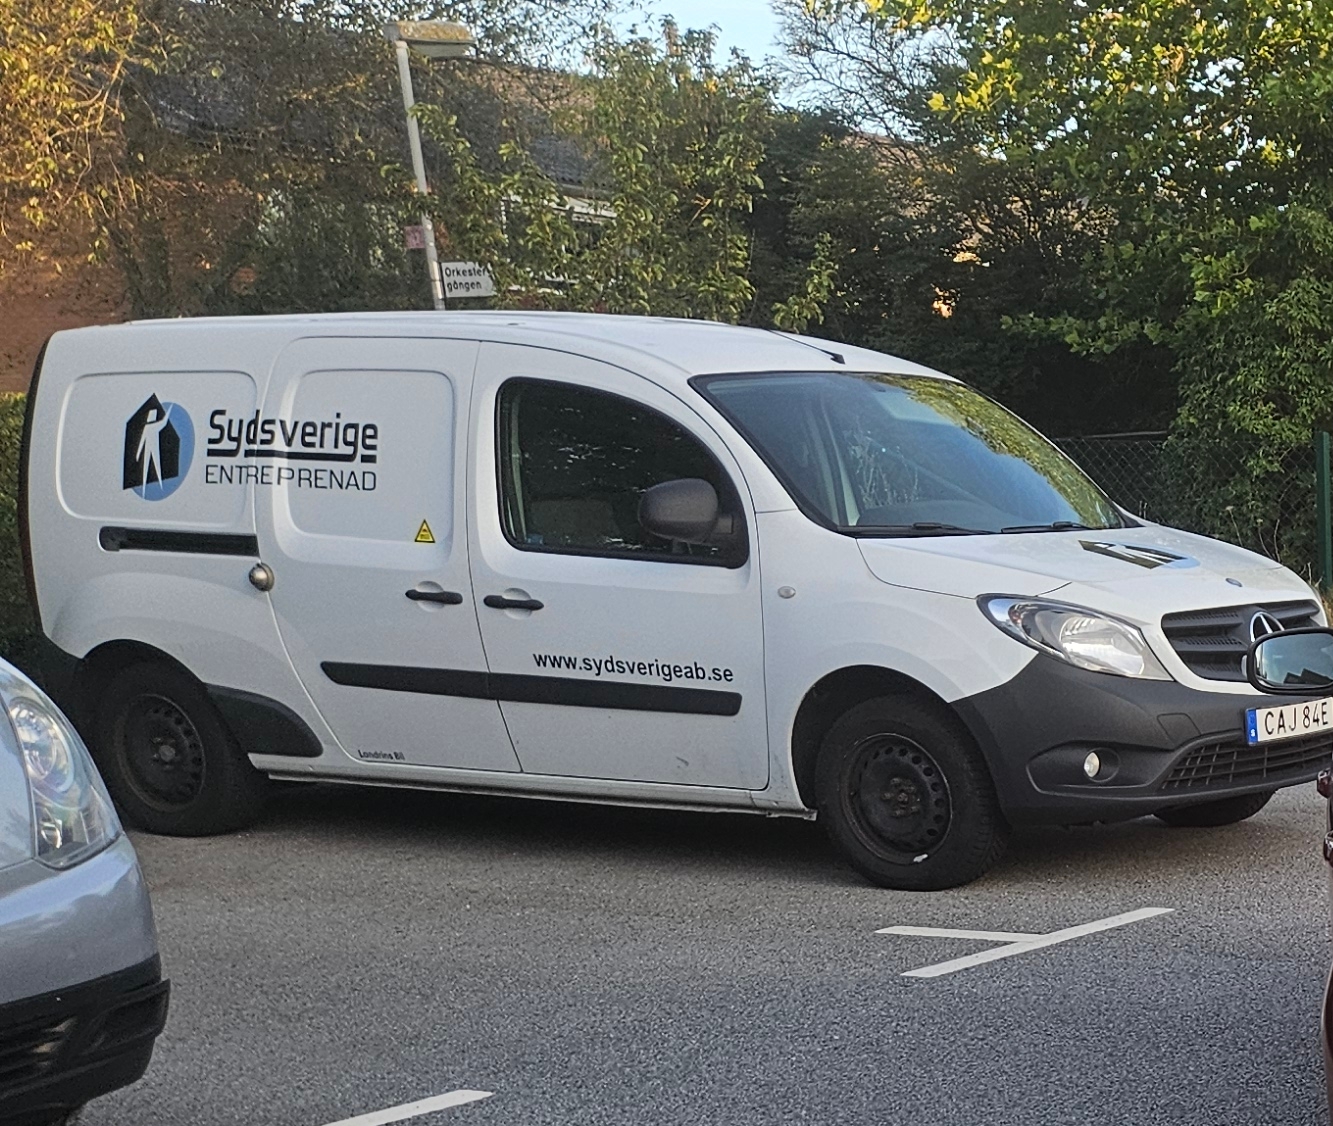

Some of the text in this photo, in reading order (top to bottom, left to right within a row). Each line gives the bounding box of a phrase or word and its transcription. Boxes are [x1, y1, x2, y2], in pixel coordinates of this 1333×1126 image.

[207, 409, 378, 463] Sydsverige
[205, 464, 377, 491] ENTREPRENAD
[533, 653, 733, 682] www.sydsverigeab.se
[1264, 701, 1328, 735] CAJ 84E
